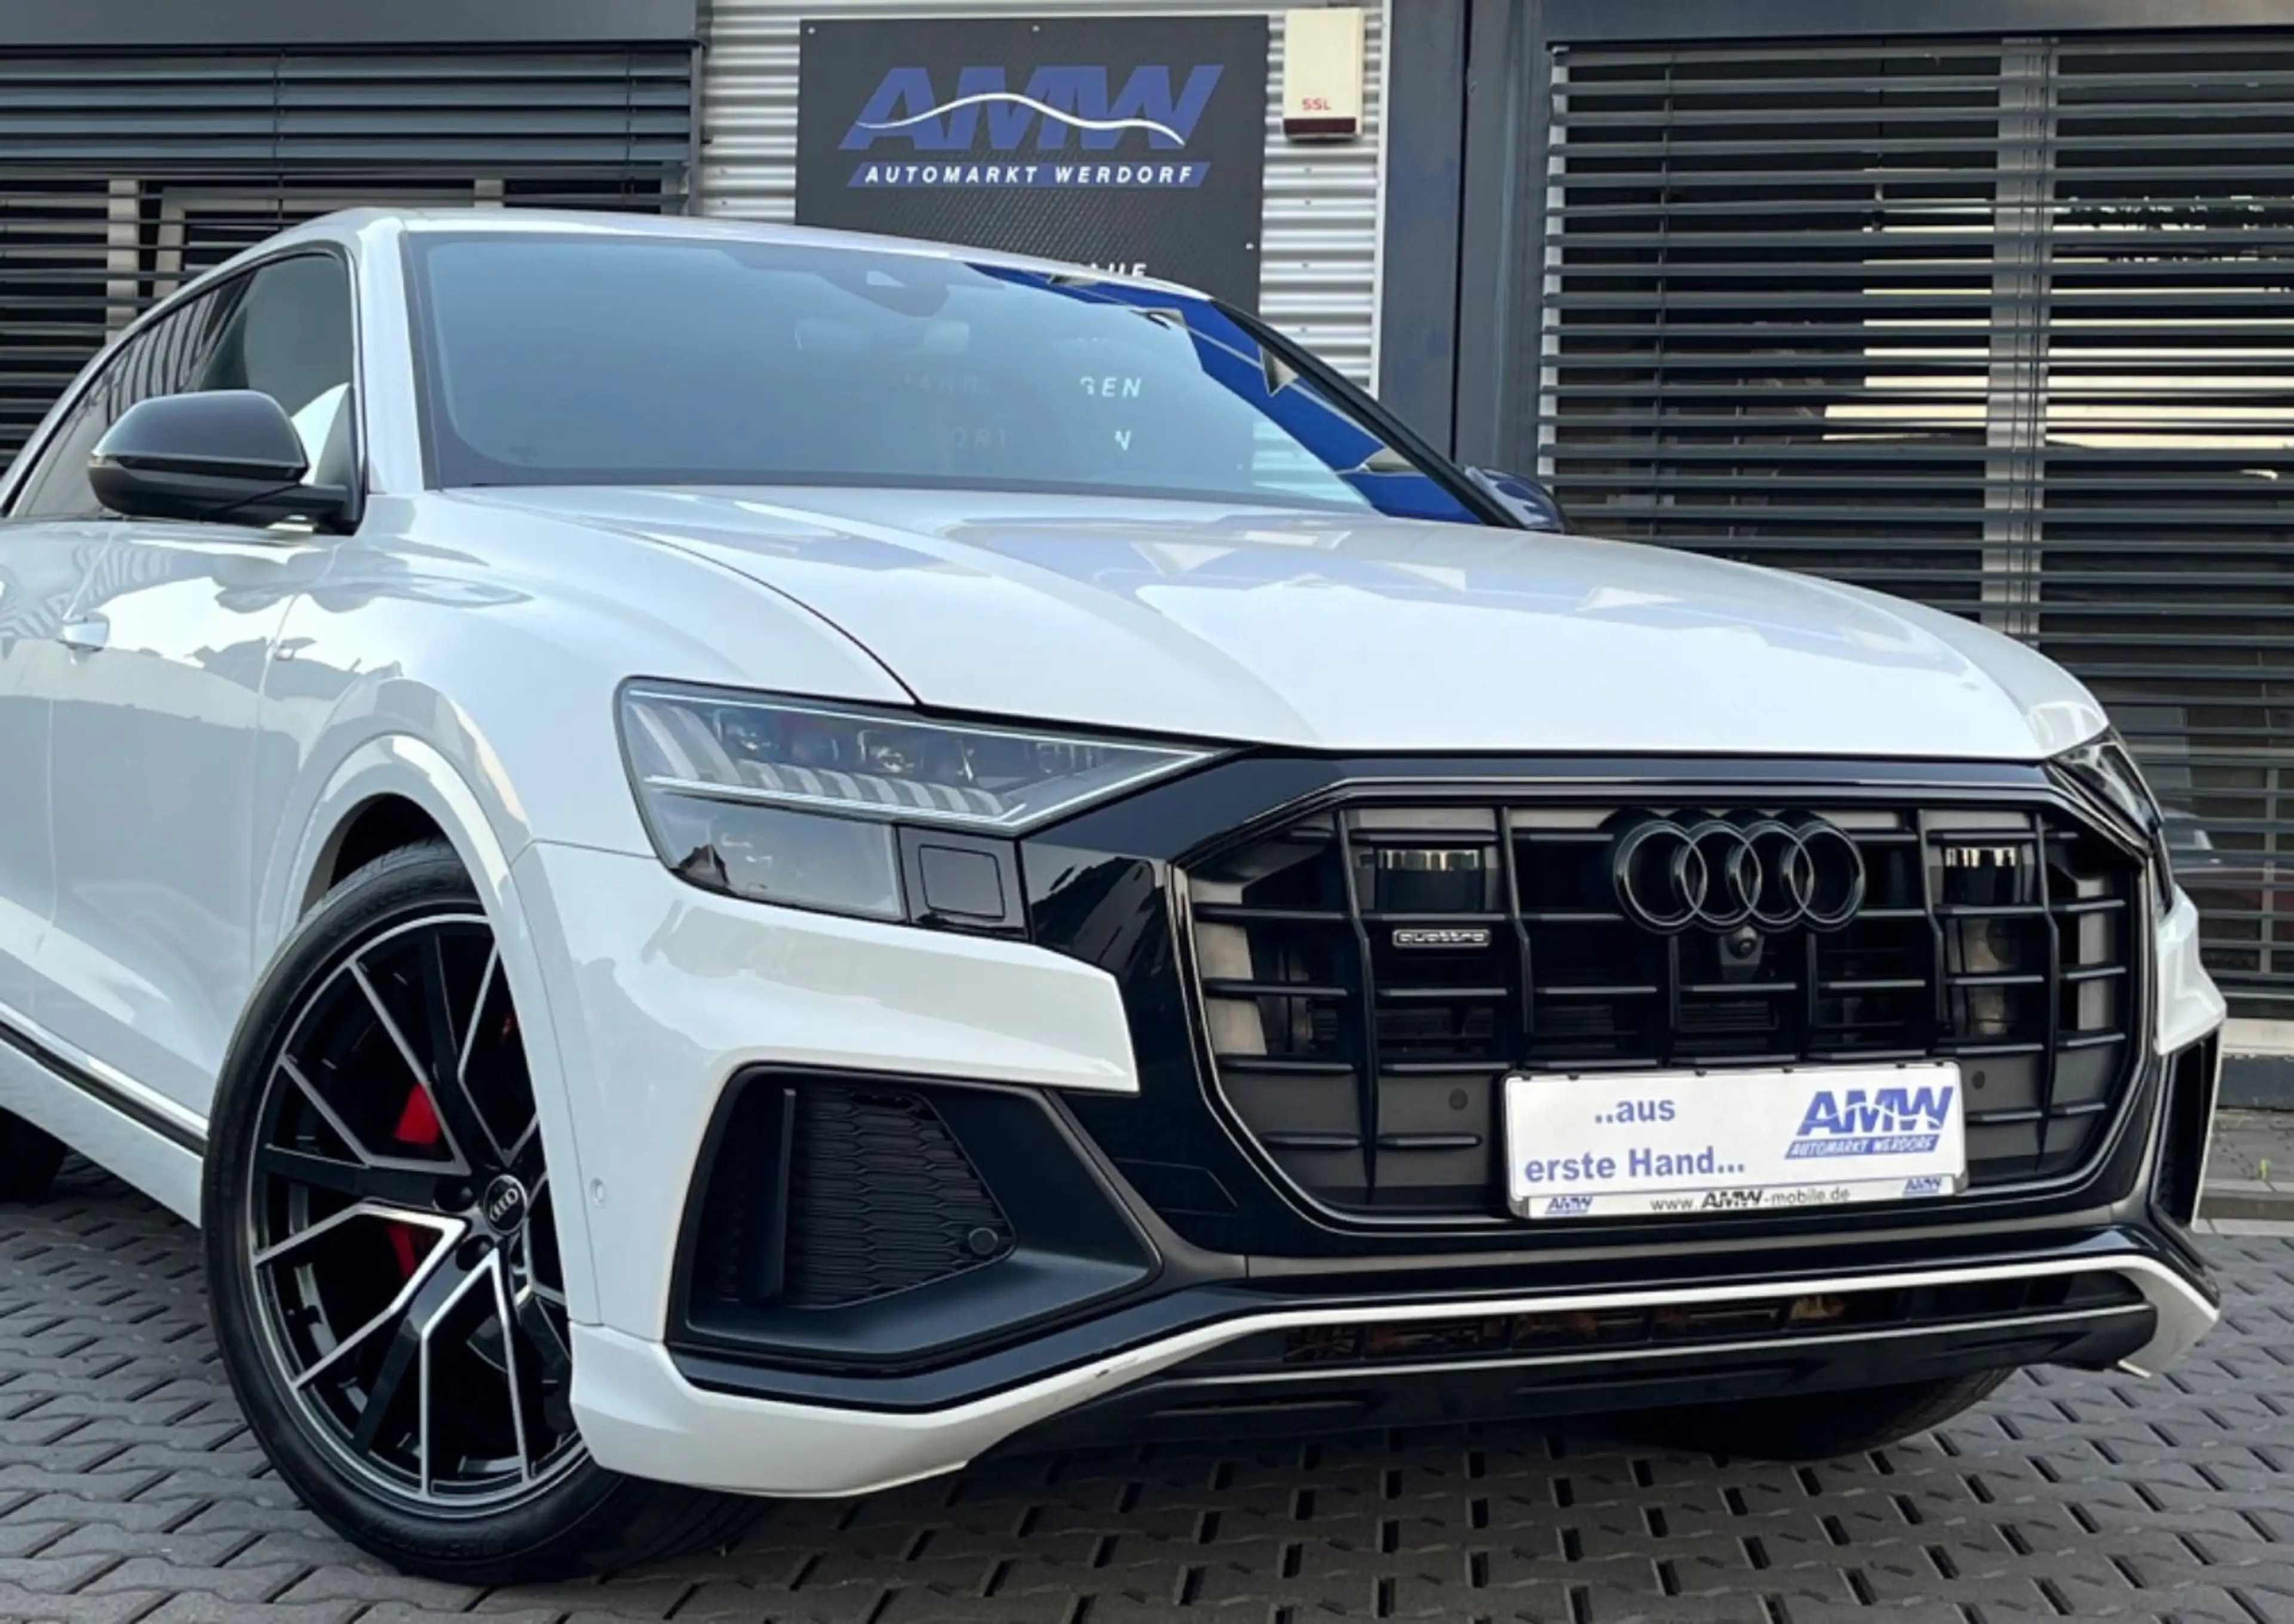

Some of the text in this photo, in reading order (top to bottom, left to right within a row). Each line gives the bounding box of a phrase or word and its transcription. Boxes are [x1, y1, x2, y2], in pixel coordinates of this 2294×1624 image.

[838, 66, 1224, 150] AMW
[1302, 97, 1332, 111] SSL
[865, 165, 1193, 183] AUTOMARKT WERDORF
[1397, 932, 1486, 945] quattro
[1796, 1086, 1954, 1136] AMW
[1524, 1152, 1617, 1183] erste
